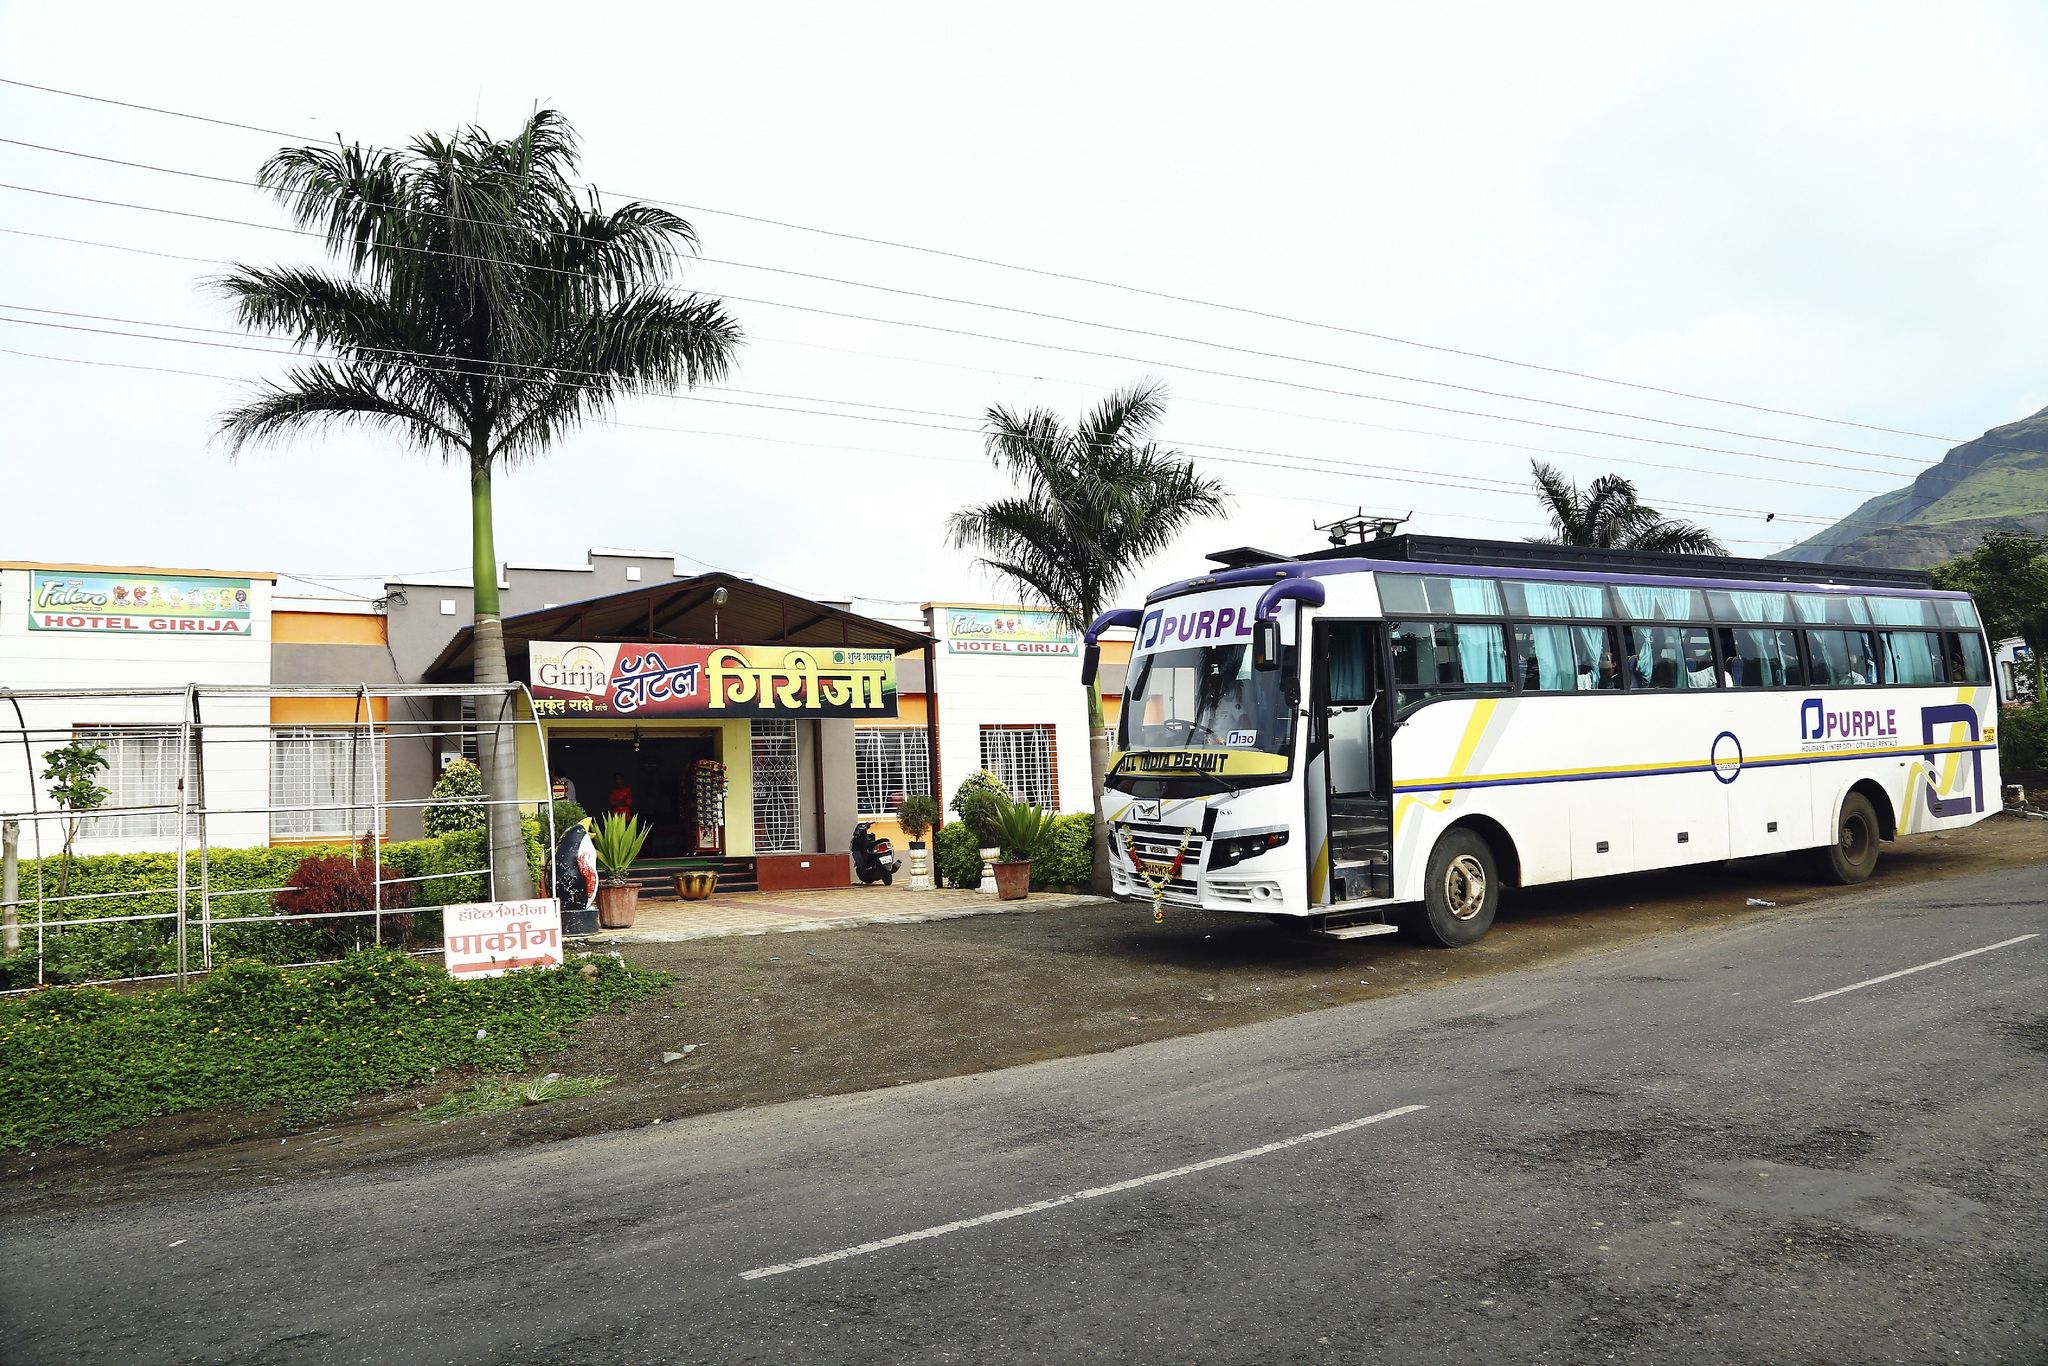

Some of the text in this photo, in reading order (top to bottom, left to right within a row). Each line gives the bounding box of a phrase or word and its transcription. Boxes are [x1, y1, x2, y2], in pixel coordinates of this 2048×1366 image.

[38, 580, 107, 608] Falero
[44, 615, 240, 632] HOTEL GIRIJA
[956, 641, 1070, 653] HOTEL GIRIJA
[534, 654, 560, 664] Hotel
[538, 663, 606, 692] Girija
[612, 648, 886, 711] हॉटेल गिरीजा
[1827, 709, 1897, 738] PURPLE
[1801, 744, 1826, 752] HOLIDAYS
[1174, 753, 1229, 773] PERMIT
